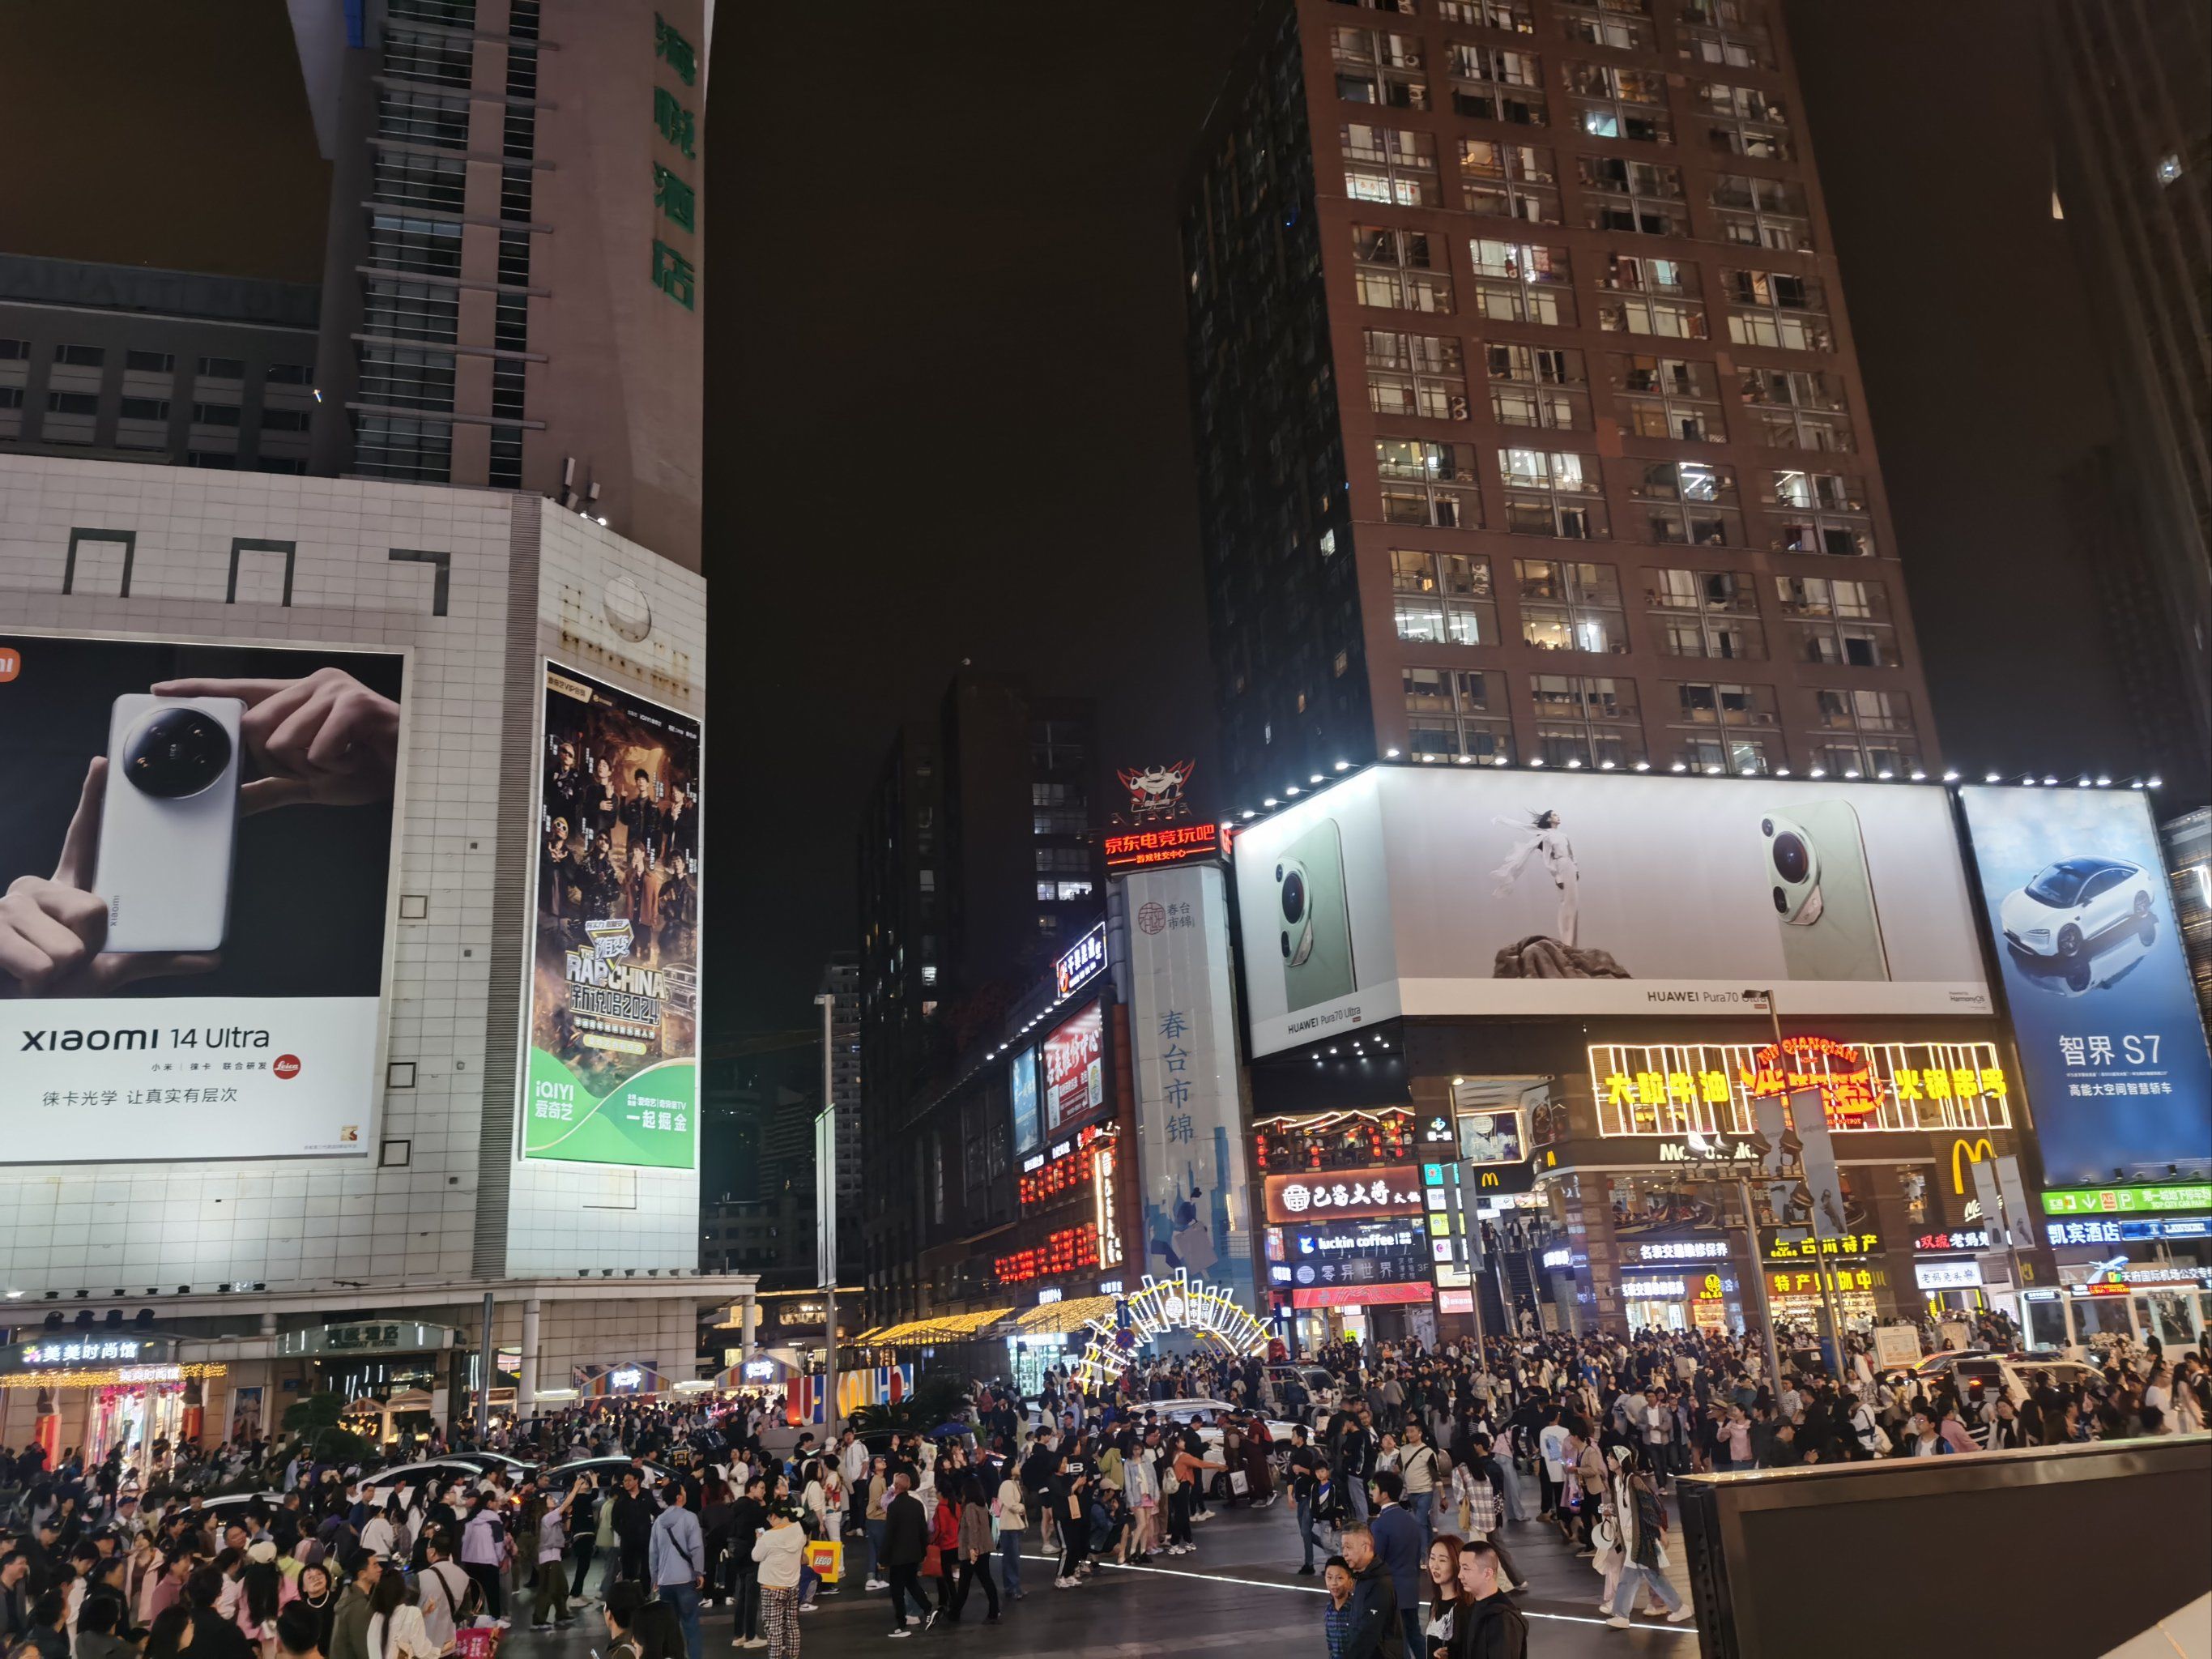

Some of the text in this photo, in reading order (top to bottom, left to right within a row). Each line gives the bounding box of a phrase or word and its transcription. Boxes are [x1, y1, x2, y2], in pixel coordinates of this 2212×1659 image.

[1105, 824, 1216, 855] 京东电竞玩吧
[1136, 850, 1187, 864] 游戏社交中心
[1166, 902, 1191, 915] 春台
[581, 948, 595, 959] THE
[566, 953, 607, 985] RAP
[608, 965, 666, 999] CHINA
[1647, 991, 1699, 1002] HUAWEI
[1288, 1017, 1319, 1035] HUAWEI
[1345, 1006, 1362, 1018] Ultra
[20, 1026, 270, 1051] xiaomi 14 Ultra
[1782, 1036, 1859, 1063] QIANQIAN
[2058, 1034, 2160, 1066] 智界 S7
[151, 1062, 173, 1072] 小米
[222, 1061, 268, 1072] 联合研发
[274, 1060, 300, 1072] Leica
[1157, 1009, 1195, 1145] 春台市锦
[42, 1087, 238, 1107] 徕卡光学 让真实有层次
[535, 1080, 573, 1101] iQIYI
[2068, 1081, 2173, 1097] 高能大空间智慧轿车
[535, 1100, 573, 1121] 爱奇艺
[626, 1109, 687, 1132] 一起掘金
[2165, 1201, 2178, 1209] CITY
[2192, 1200, 2207, 1208] PARK
[1319, 1233, 1395, 1251] luckin coffee
[2047, 1222, 2120, 1245] 凯宾酒店
[1417, 1263, 1430, 1273] 3F
[42, 1341, 139, 1363] 美美时尚馆
[813, 1554, 833, 1567] LEGO
